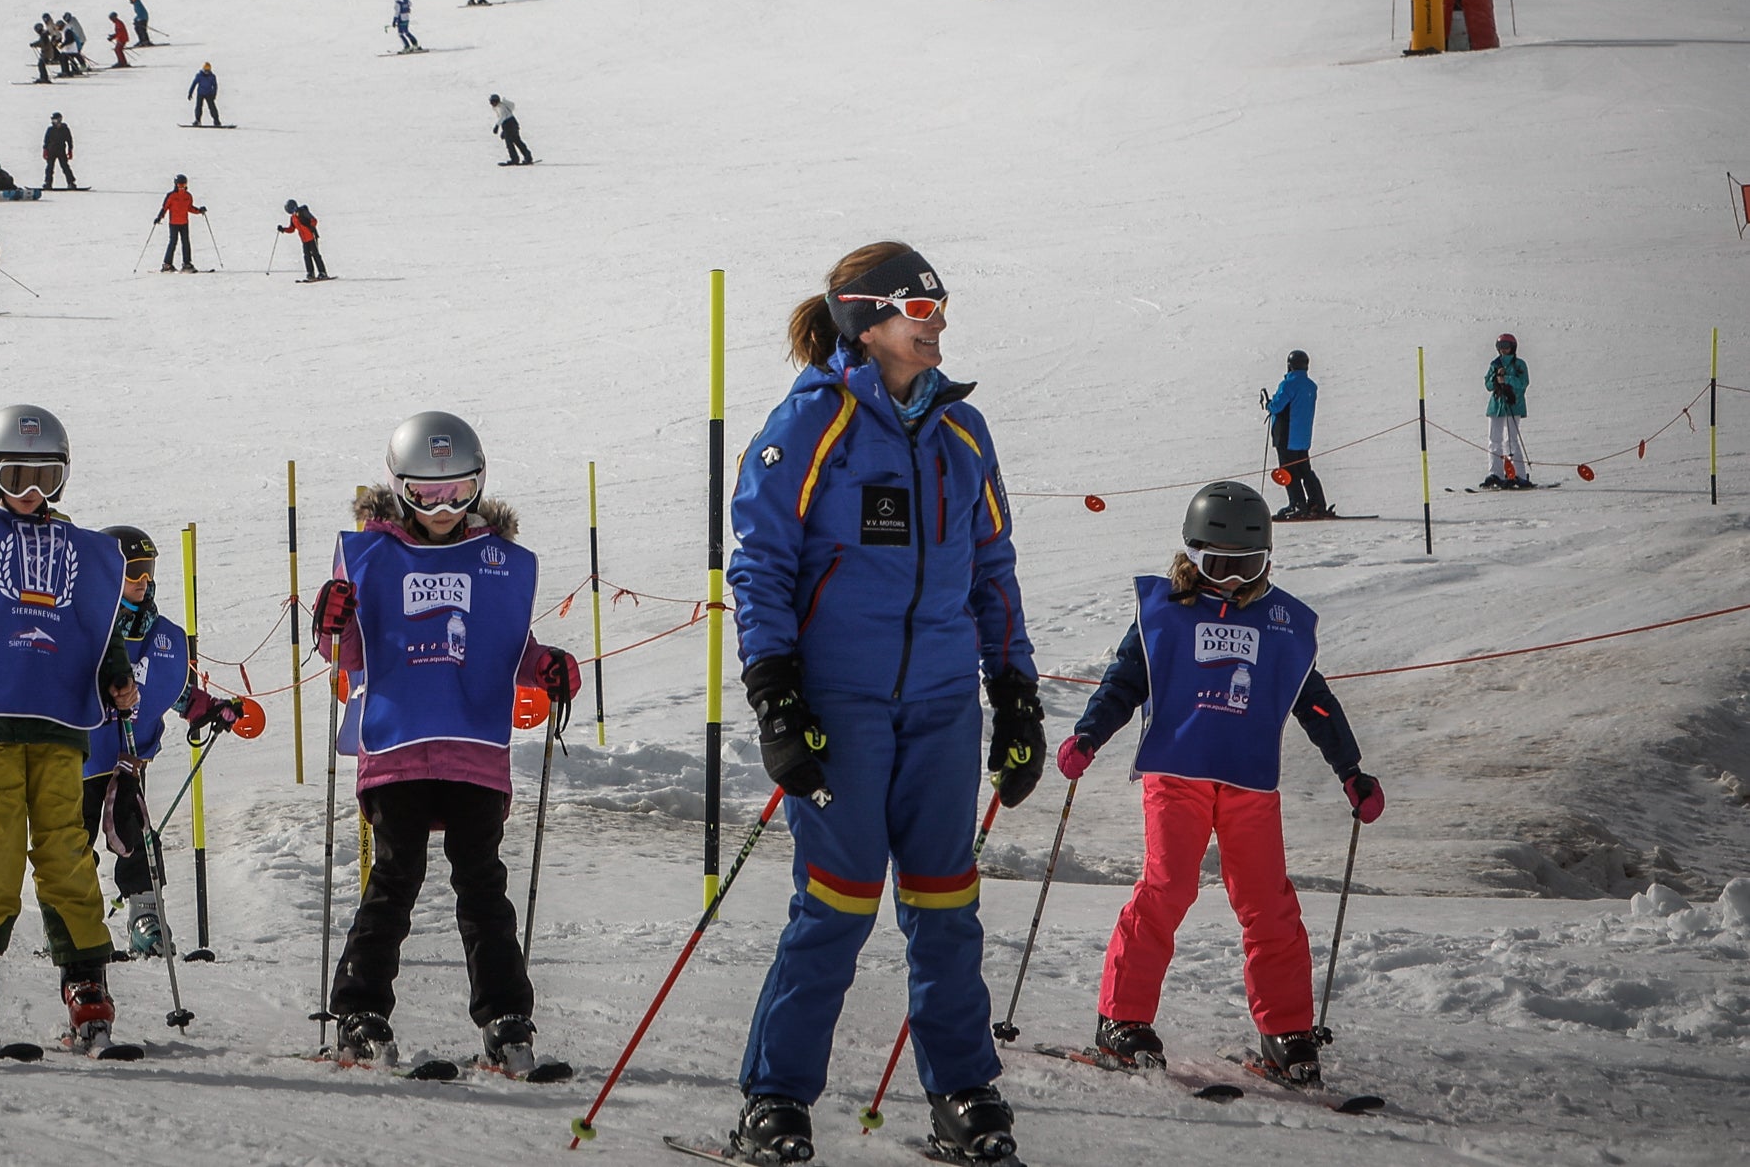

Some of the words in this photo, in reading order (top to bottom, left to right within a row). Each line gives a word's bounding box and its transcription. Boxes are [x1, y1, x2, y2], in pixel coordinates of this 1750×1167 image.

[409, 577, 465, 590] AQUA
[411, 590, 463, 602] DEUS
[11, 607, 61, 622] SIERRANEVADA
[1201, 627, 1254, 642] AQUA
[1203, 640, 1251, 655] DEUS
[362, 822, 370, 865] LISKI
